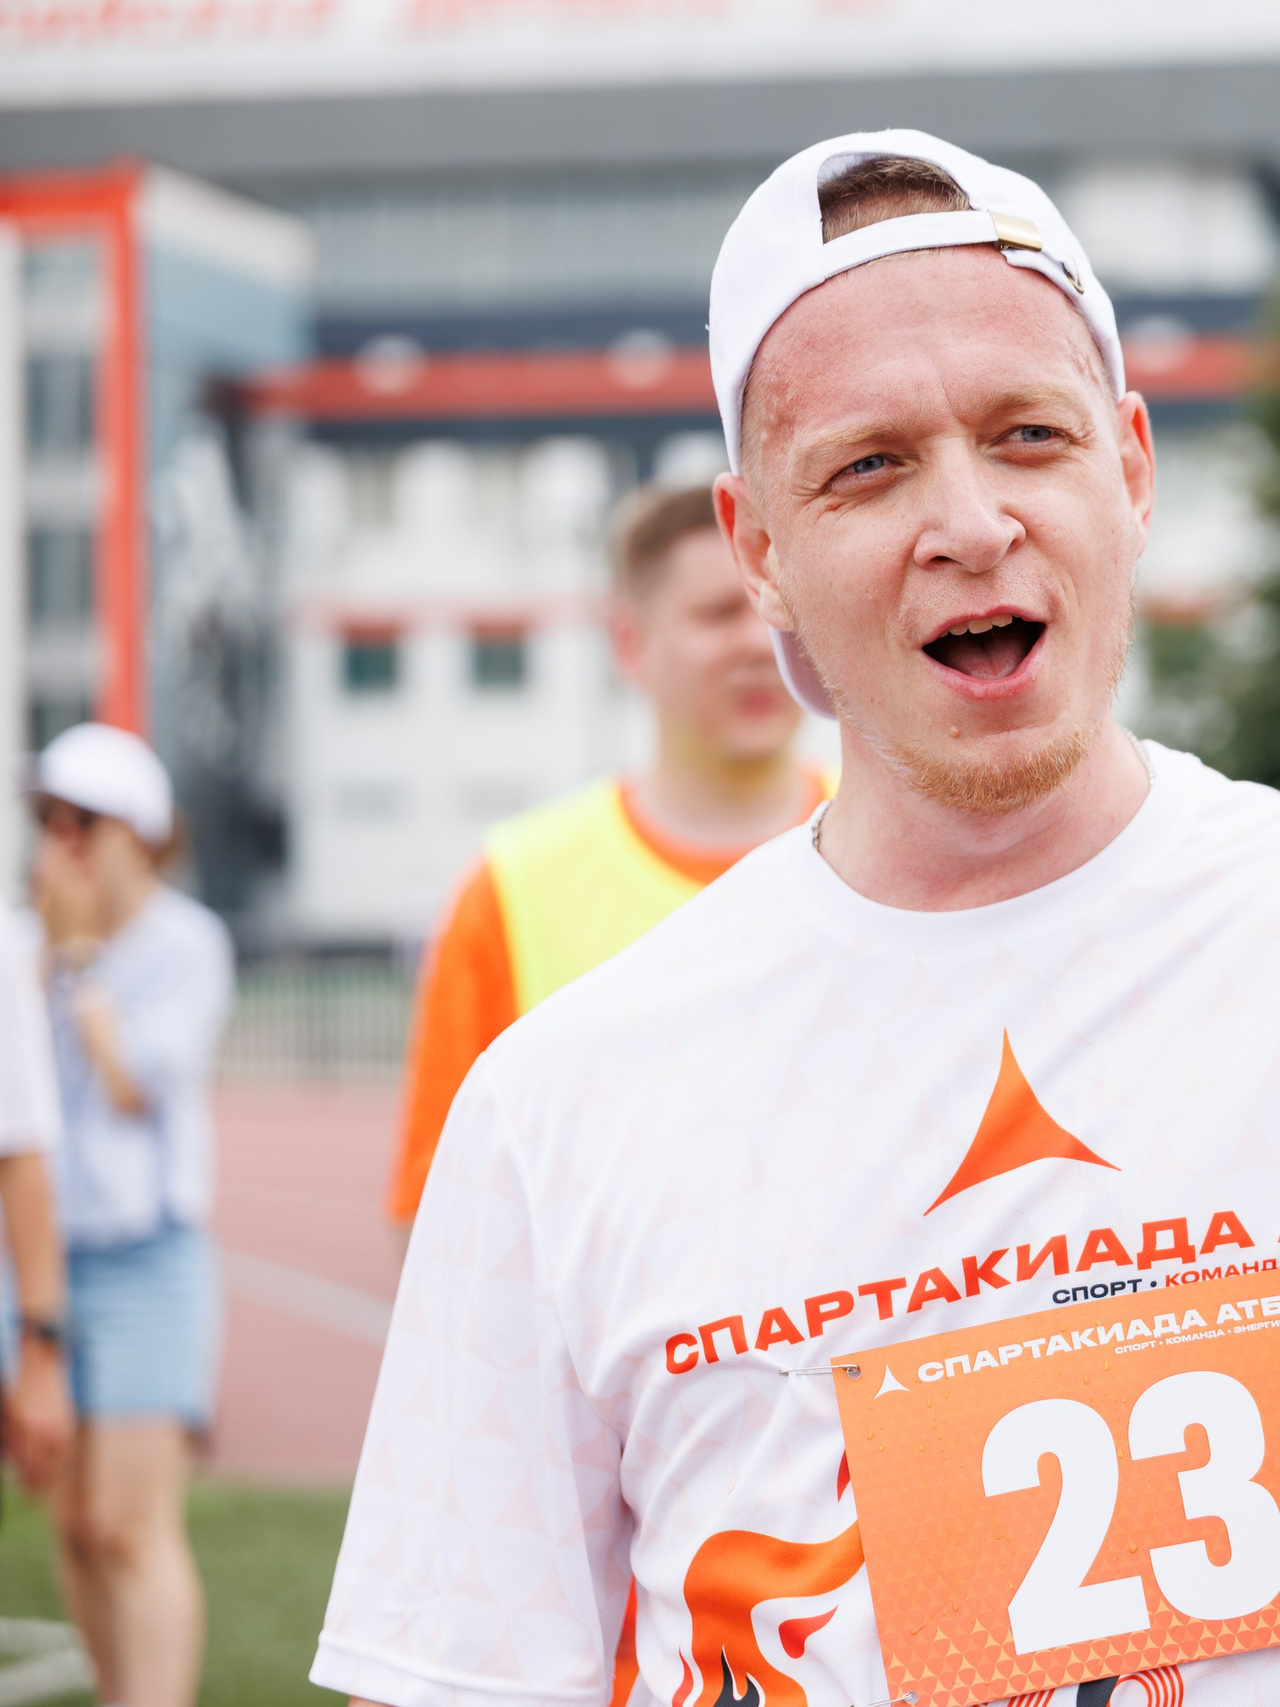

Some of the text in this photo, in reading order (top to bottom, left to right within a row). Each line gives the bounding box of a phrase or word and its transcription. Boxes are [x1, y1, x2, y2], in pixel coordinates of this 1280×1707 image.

[665, 1211, 1255, 1374] СПАРТАКИАДА
[1052, 1278, 1142, 1304] СПОРТ
[917, 1309, 1207, 1384] СПАРТАКИАДА
[1115, 1340, 1156, 1354] СПОРТ
[1166, 1328, 1225, 1345] КОМАНДА
